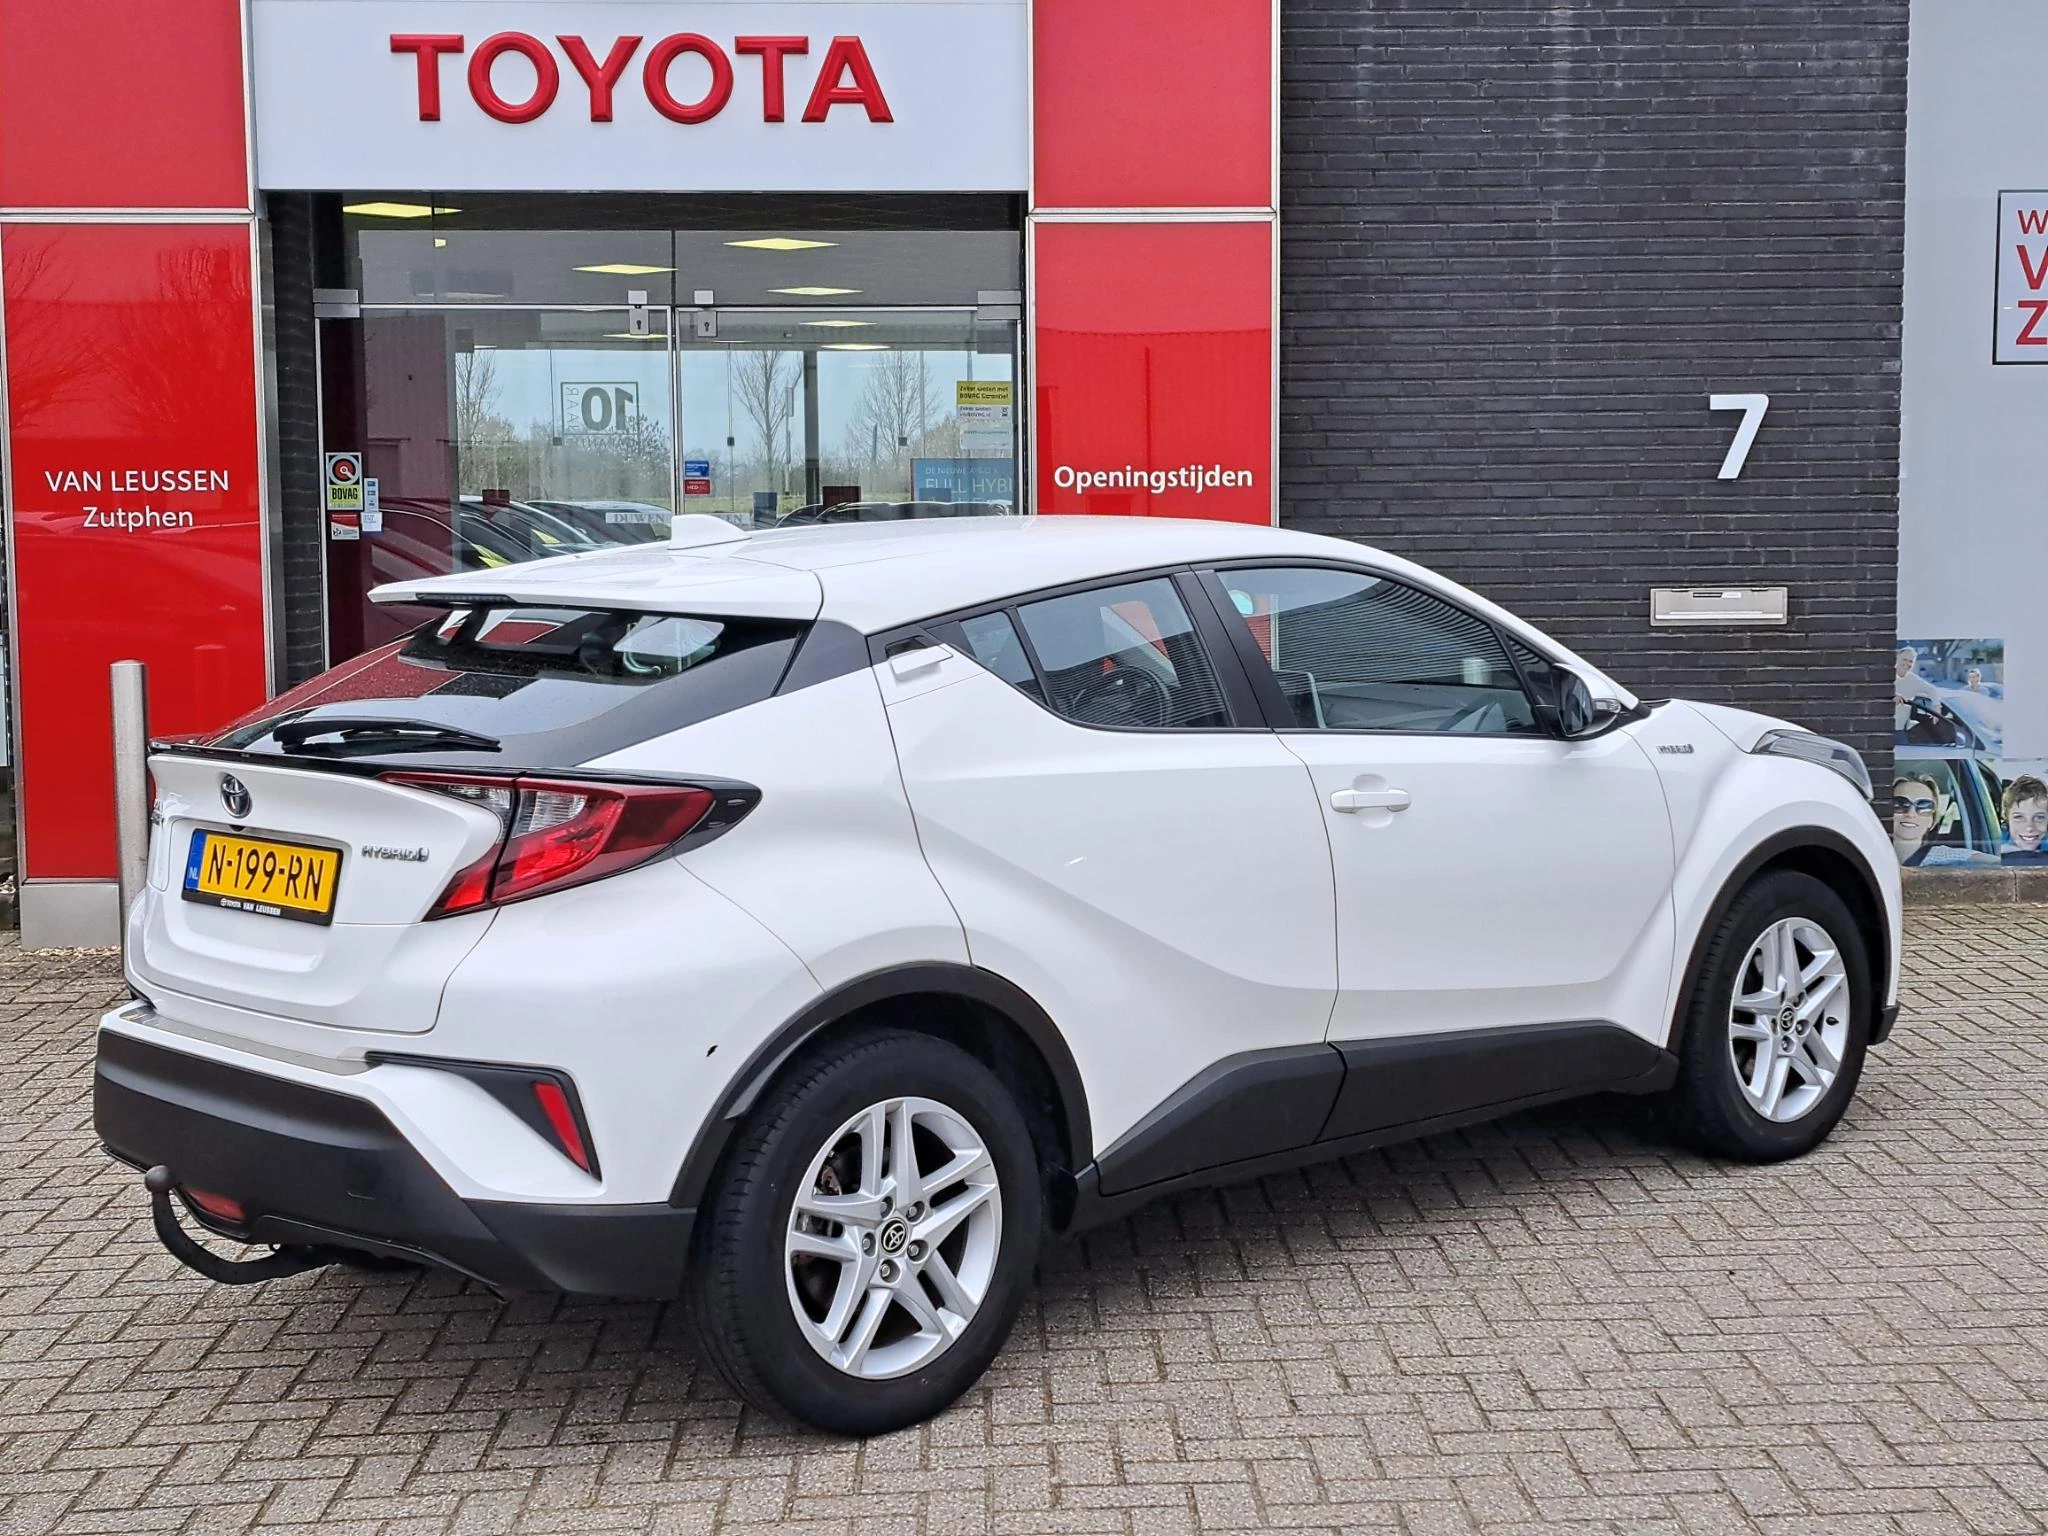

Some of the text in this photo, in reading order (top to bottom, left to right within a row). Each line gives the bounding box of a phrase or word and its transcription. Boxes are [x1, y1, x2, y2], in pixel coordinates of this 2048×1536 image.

[390, 31, 894, 124] TOYOTA
[1710, 394, 1769, 479] 7
[45, 470, 229, 492] VAN LEUSSEN
[1054, 465, 1253, 494] Openingstijden
[332, 488, 358, 500] BOVAG
[83, 505, 193, 533] Zutphen
[614, 513, 665, 524] DUWEN
[362, 844, 417, 862] HYBRID
[188, 867, 199, 880] NL
[208, 843, 324, 902] N-199-RN
[243, 902, 254, 911] VAN
